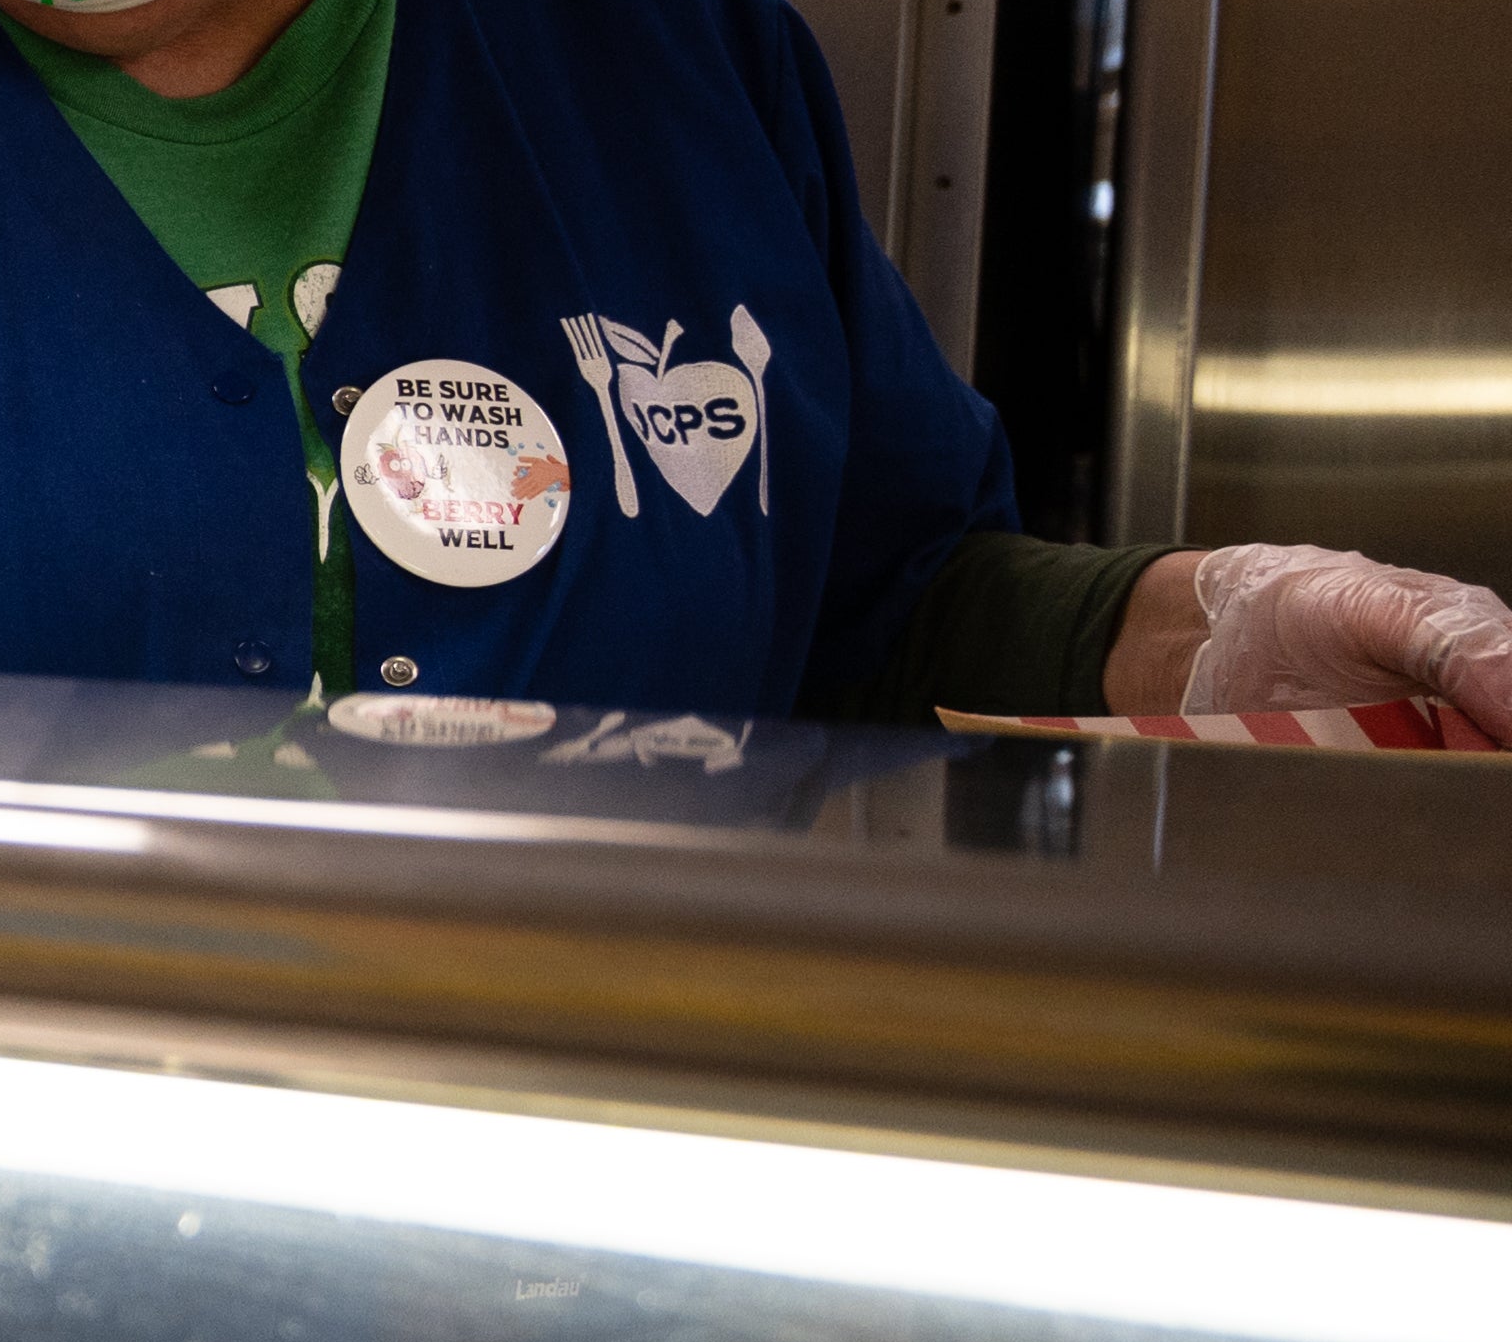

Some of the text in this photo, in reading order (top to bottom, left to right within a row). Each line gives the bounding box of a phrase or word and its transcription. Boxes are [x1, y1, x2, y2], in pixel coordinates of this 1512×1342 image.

[395, 378, 510, 402] BE SURE
[394, 402, 523, 427] TO WASH
[414, 425, 510, 449] HANDS
[421, 499, 524, 526] BERRY
[438, 527, 514, 550] WELL
[515, 1276, 581, 1301] Landau
